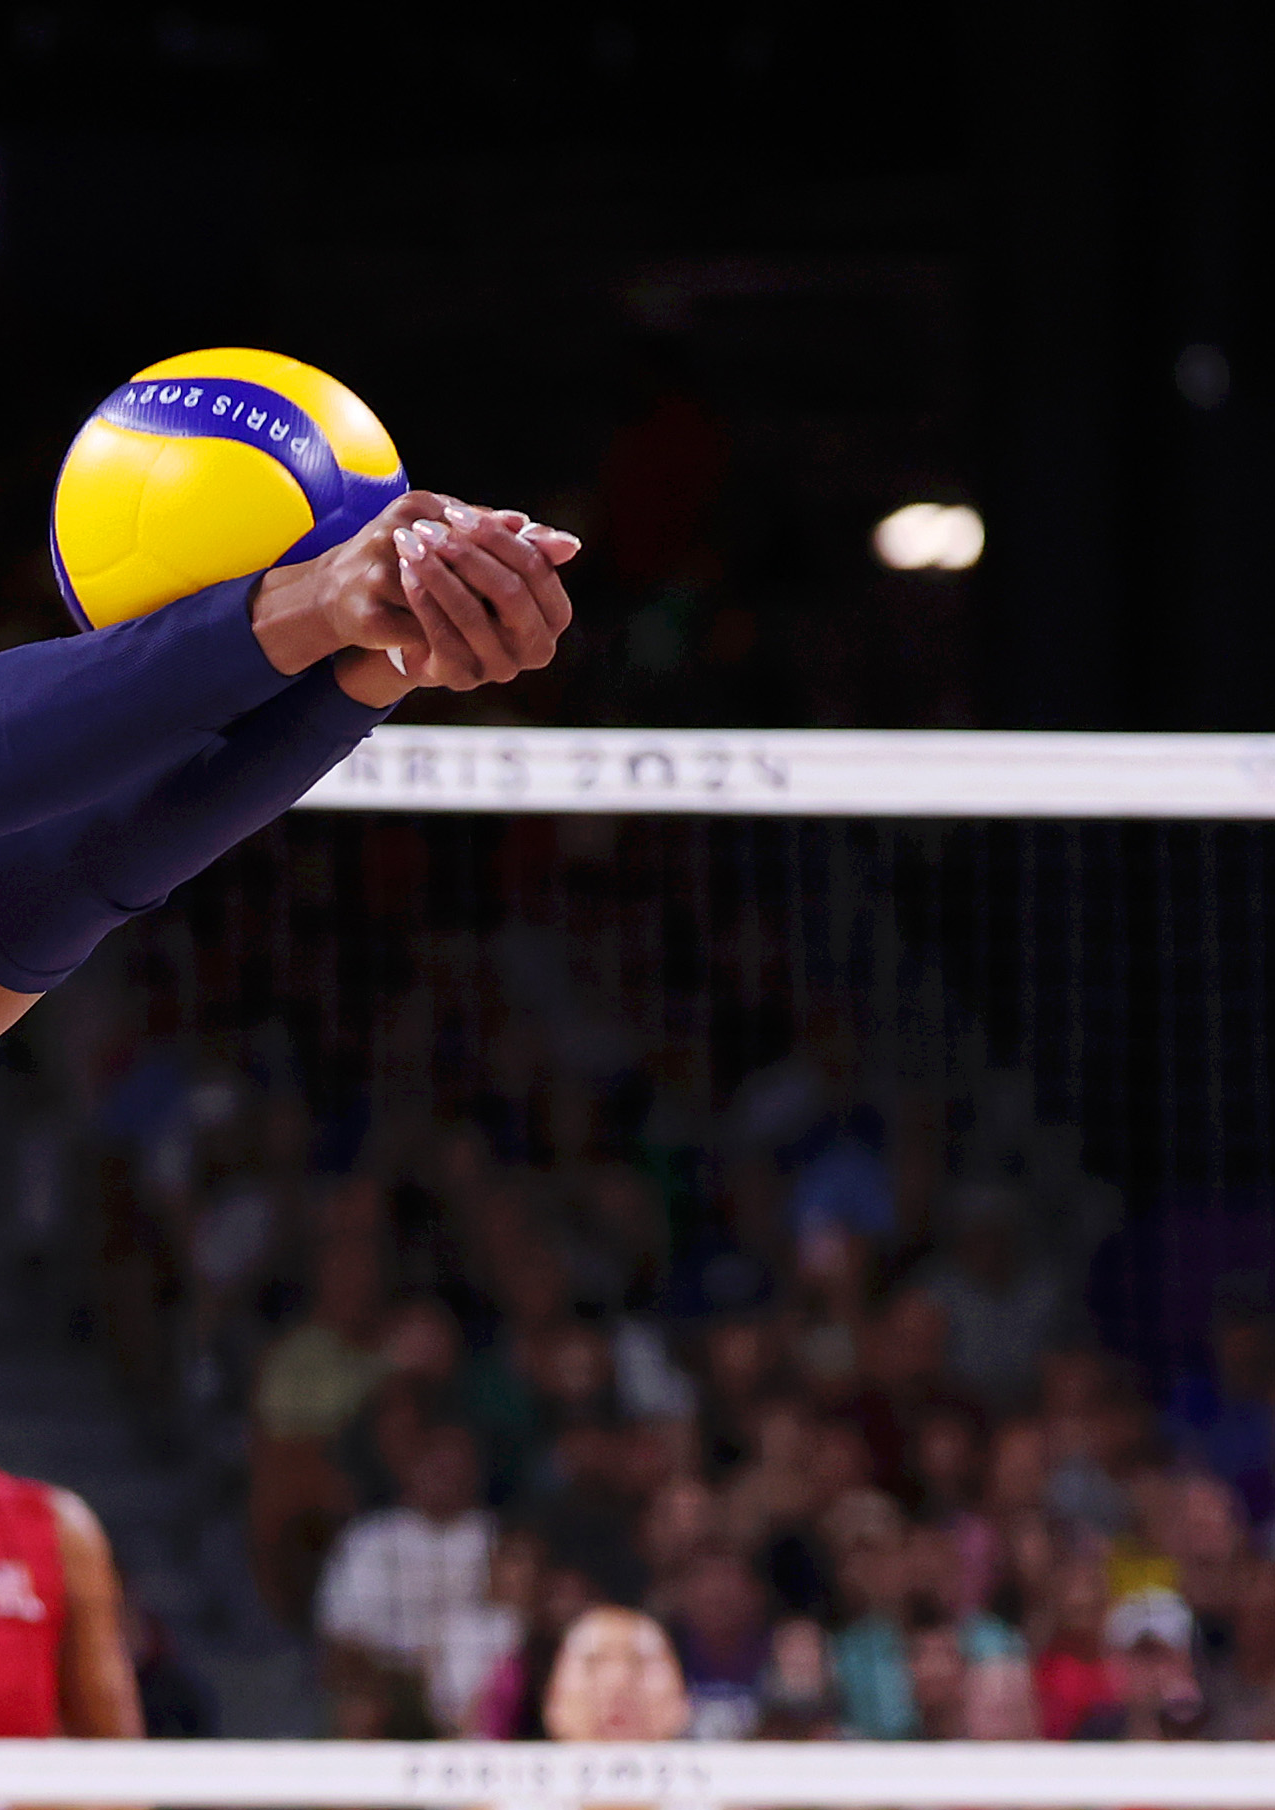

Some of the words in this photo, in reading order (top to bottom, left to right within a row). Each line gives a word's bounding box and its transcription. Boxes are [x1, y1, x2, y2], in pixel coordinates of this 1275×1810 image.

[124, 384, 204, 408] 2024
[211, 394, 310, 455] PARIS
[341, 736, 530, 790] ARIS
